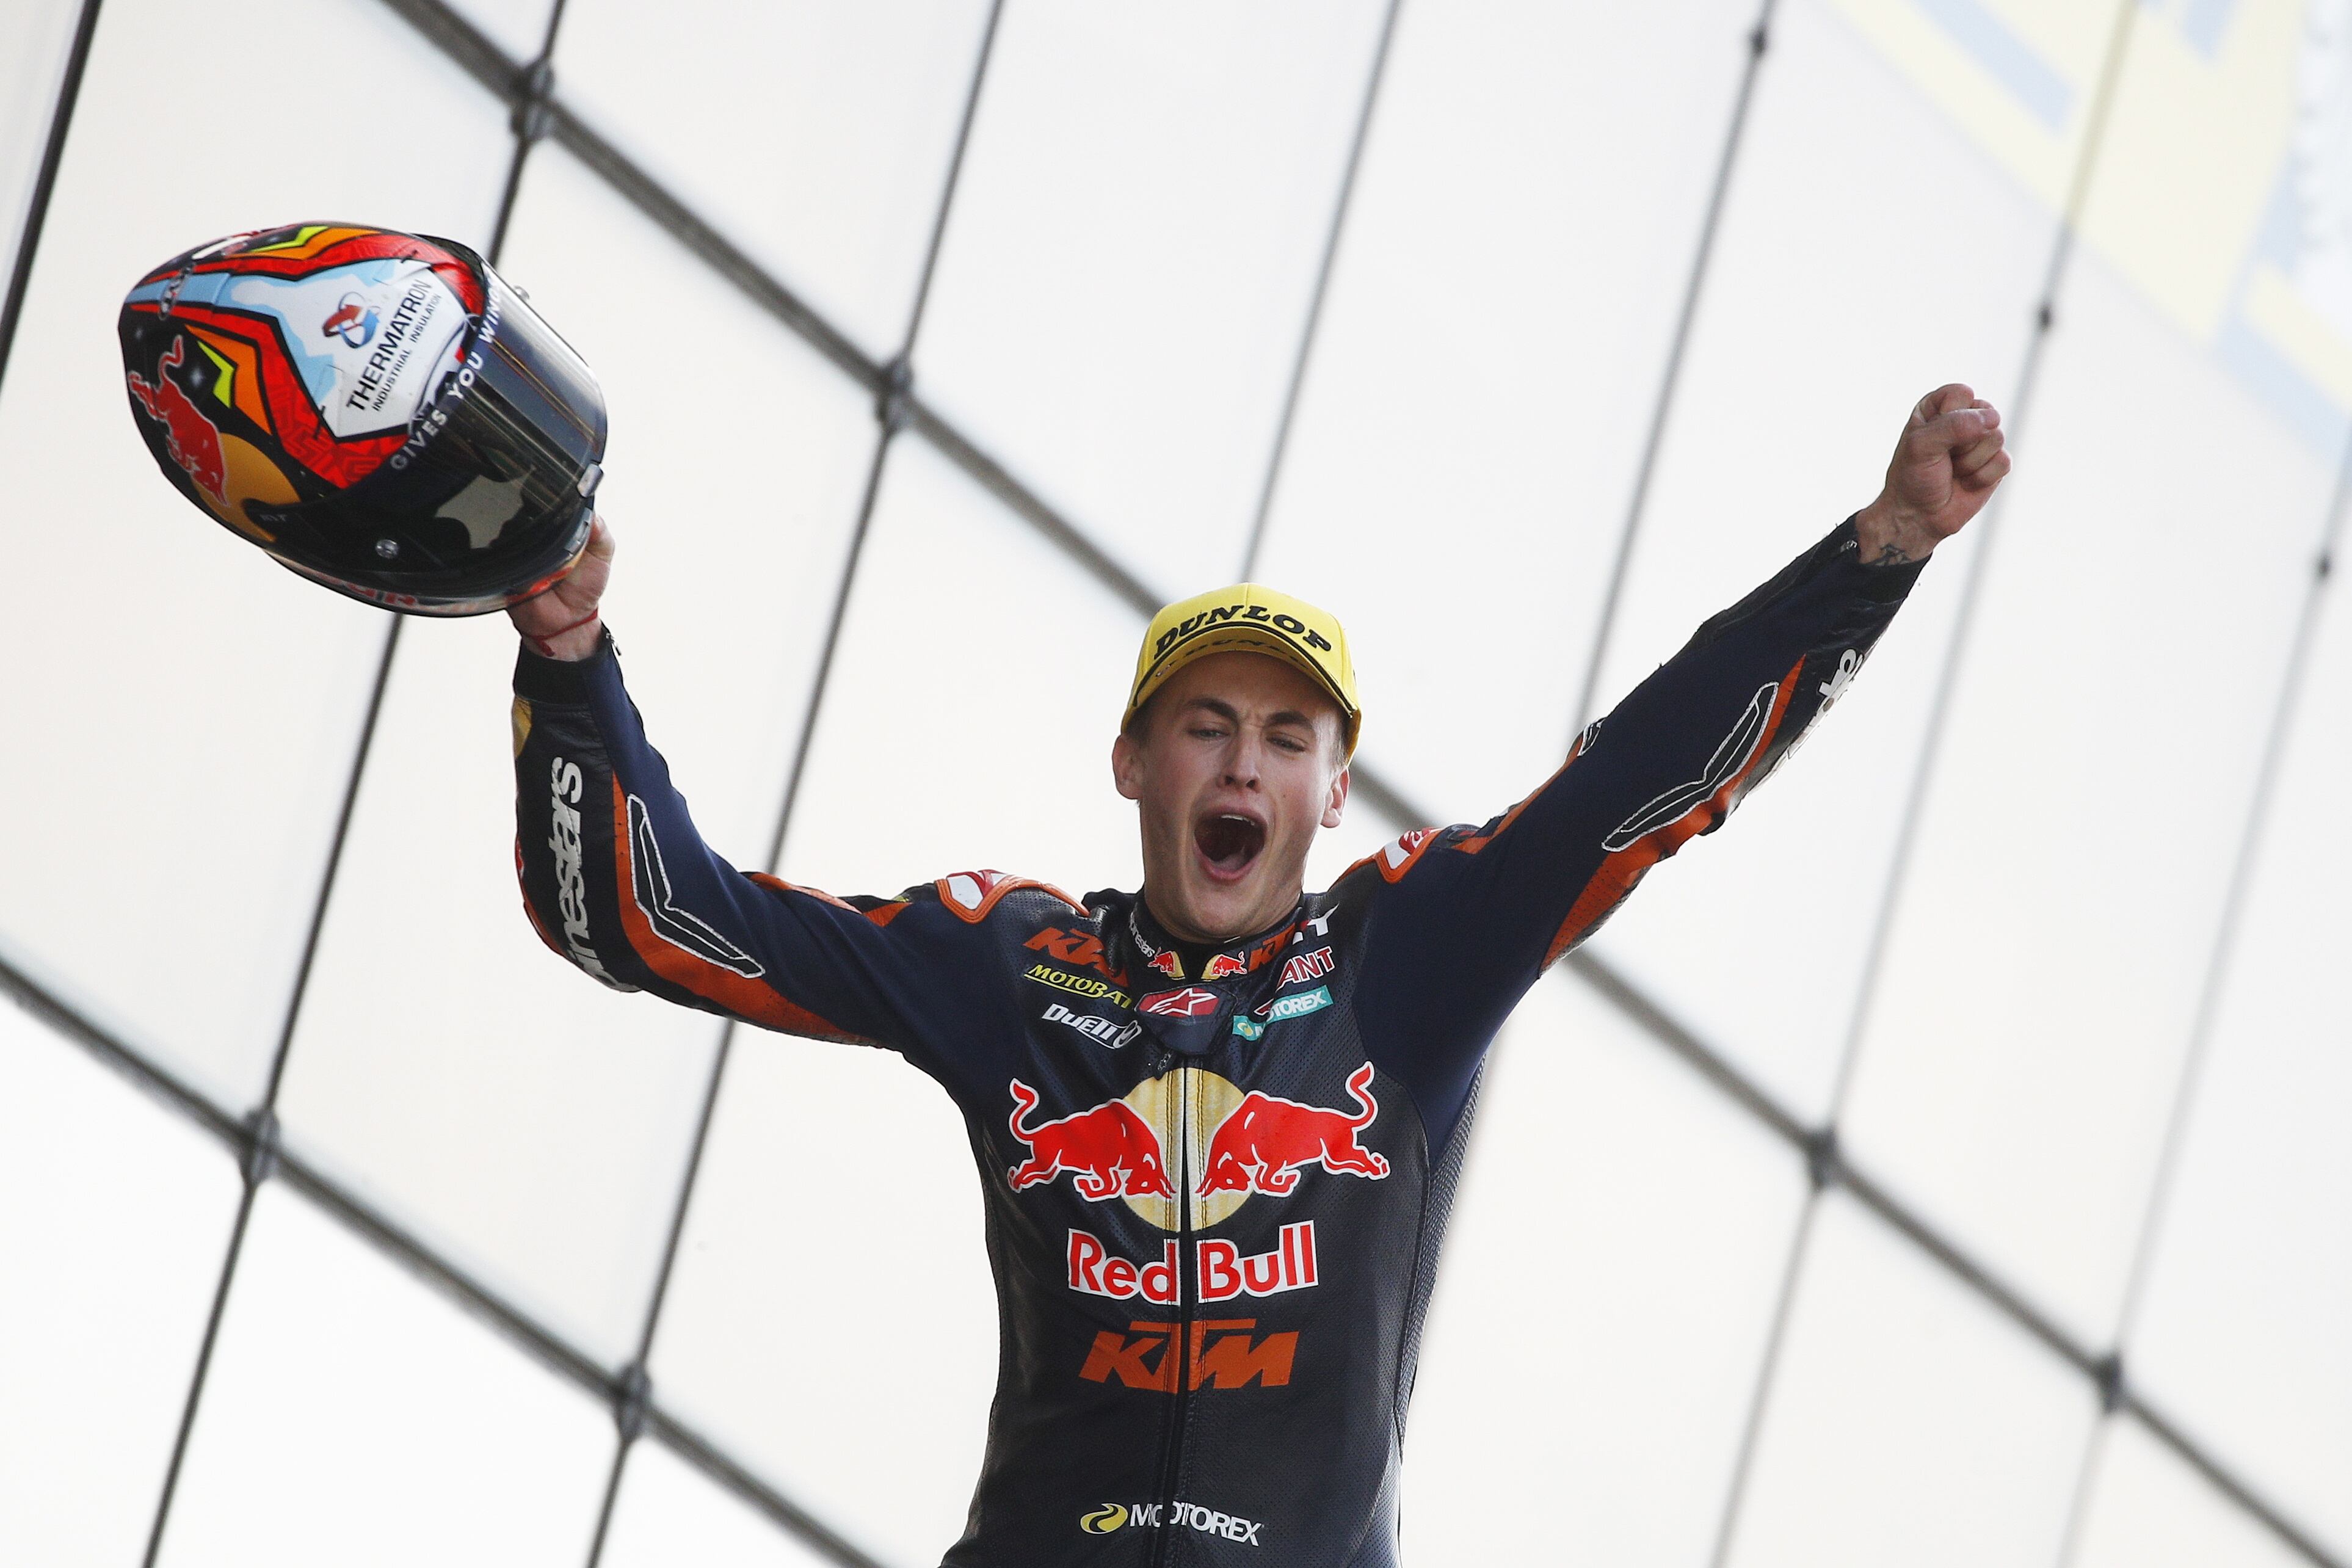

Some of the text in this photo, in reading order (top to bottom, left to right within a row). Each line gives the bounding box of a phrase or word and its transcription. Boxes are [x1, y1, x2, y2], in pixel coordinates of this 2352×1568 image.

[346, 279, 433, 413] THERMATRON
[371, 294, 442, 412] INDUSTRIAL INSULATION
[447, 351, 483, 401] YOU
[1154, 605, 1332, 660] DUNLOP
[1248, 923, 1296, 973] KT
[1274, 946, 1335, 993] ANT
[1067, 1220, 1319, 1305] Red Bull
[1078, 1318, 1299, 1394] KTM
[1130, 1500, 1262, 1547] MOTOREX
